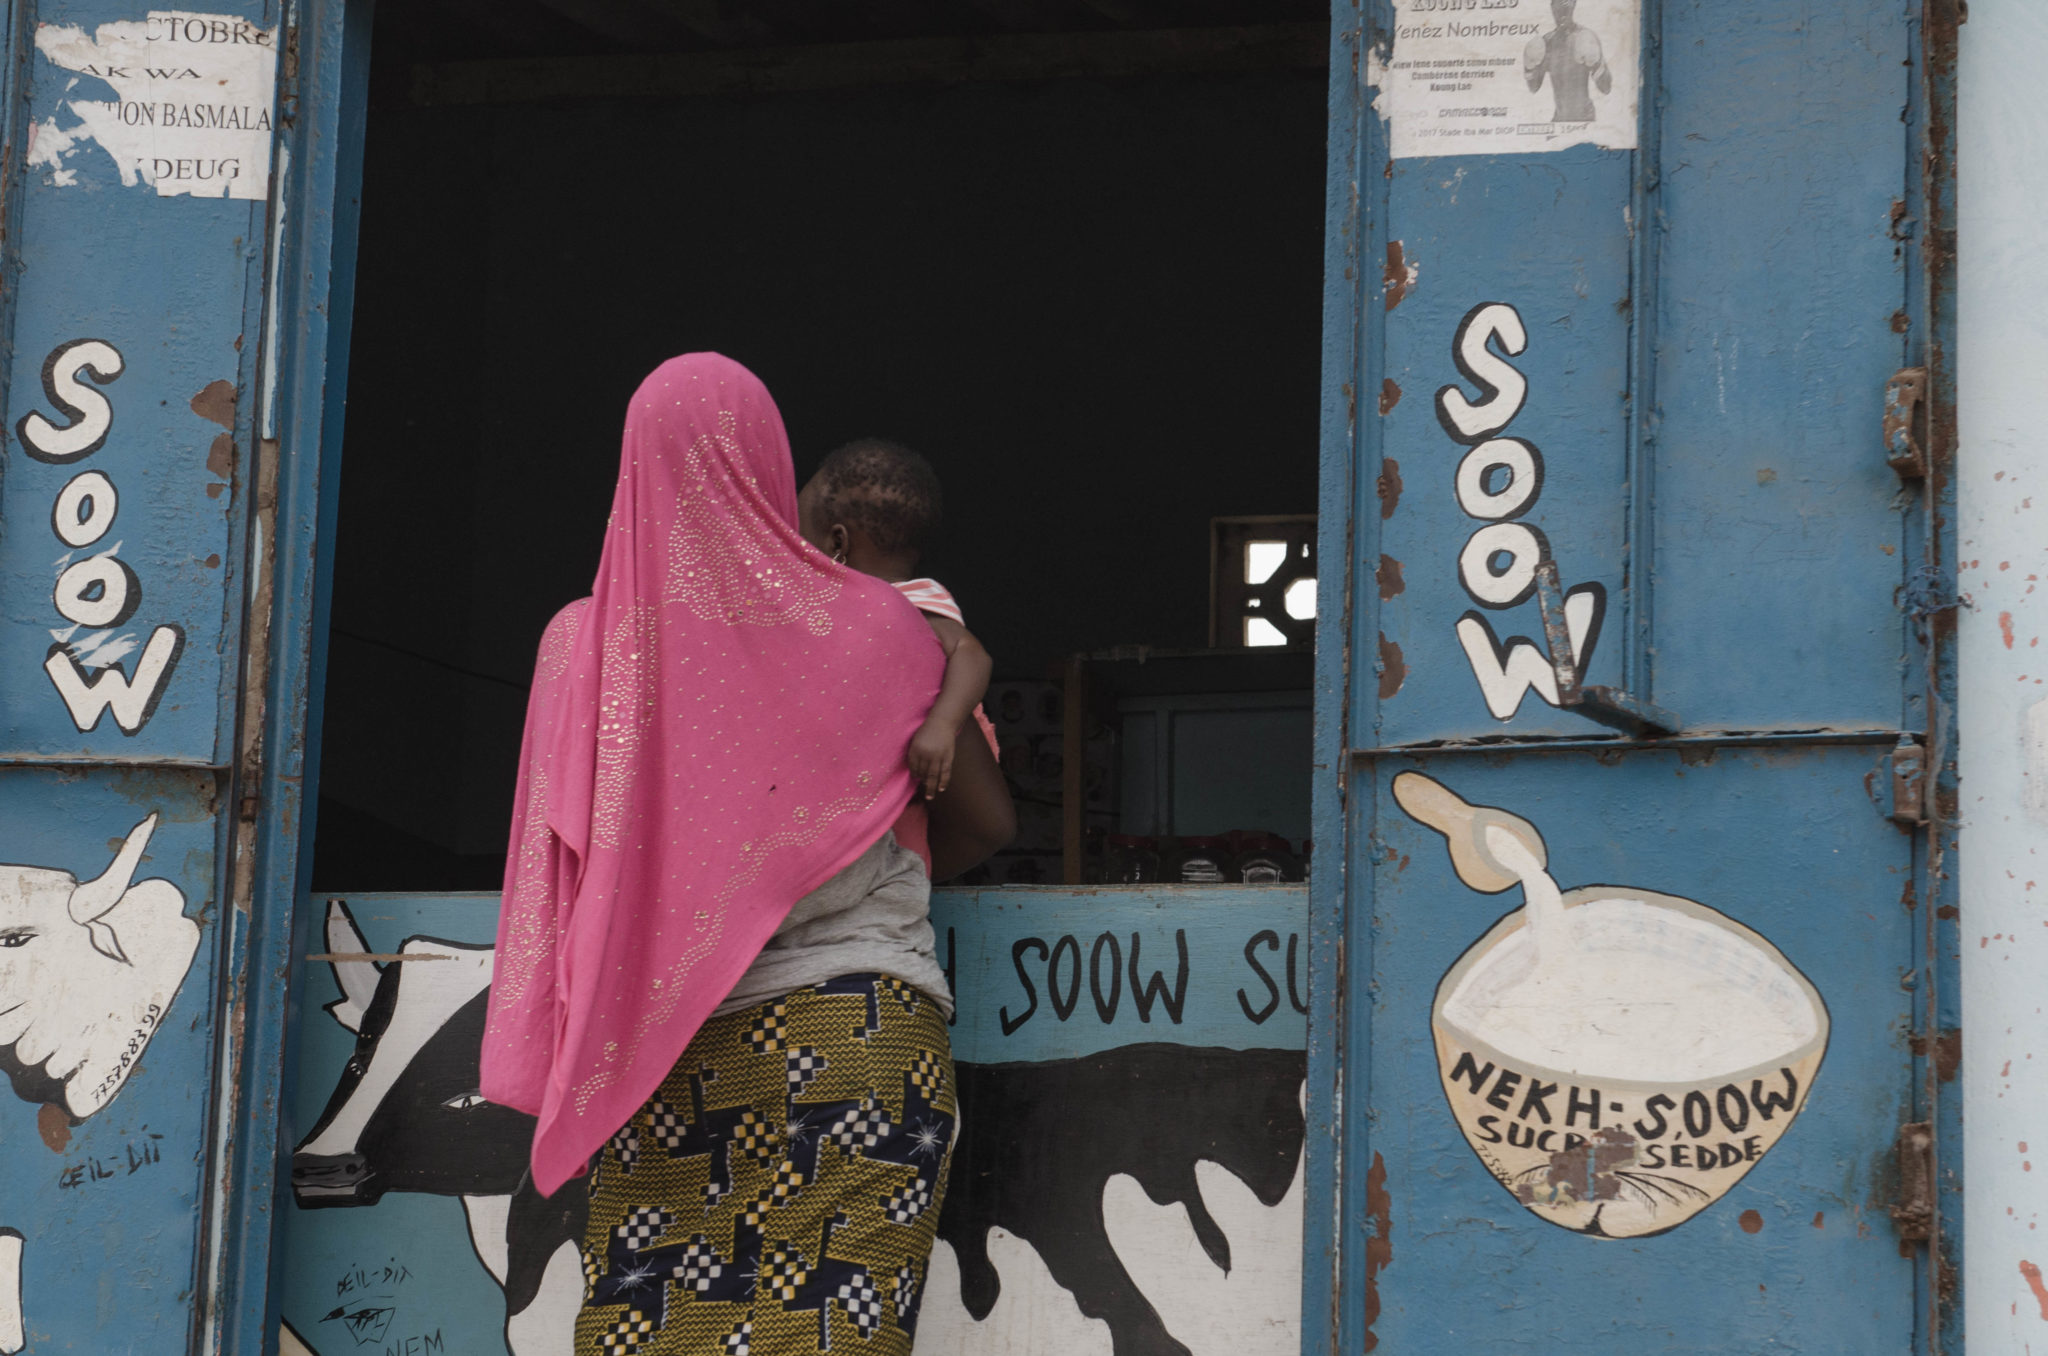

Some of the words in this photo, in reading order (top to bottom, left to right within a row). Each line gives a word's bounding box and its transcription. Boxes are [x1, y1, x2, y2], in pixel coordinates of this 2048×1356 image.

[120, 17, 275, 47] CTOBRE
[1447, 20, 1540, 38] Nombreux
[144, 68, 202, 79] WA
[162, 103, 272, 131] BASMALA
[1435, 301, 1608, 723] SOOW
[16, 338, 187, 737] SOOW
[1000, 928, 1189, 1037] SOOW
